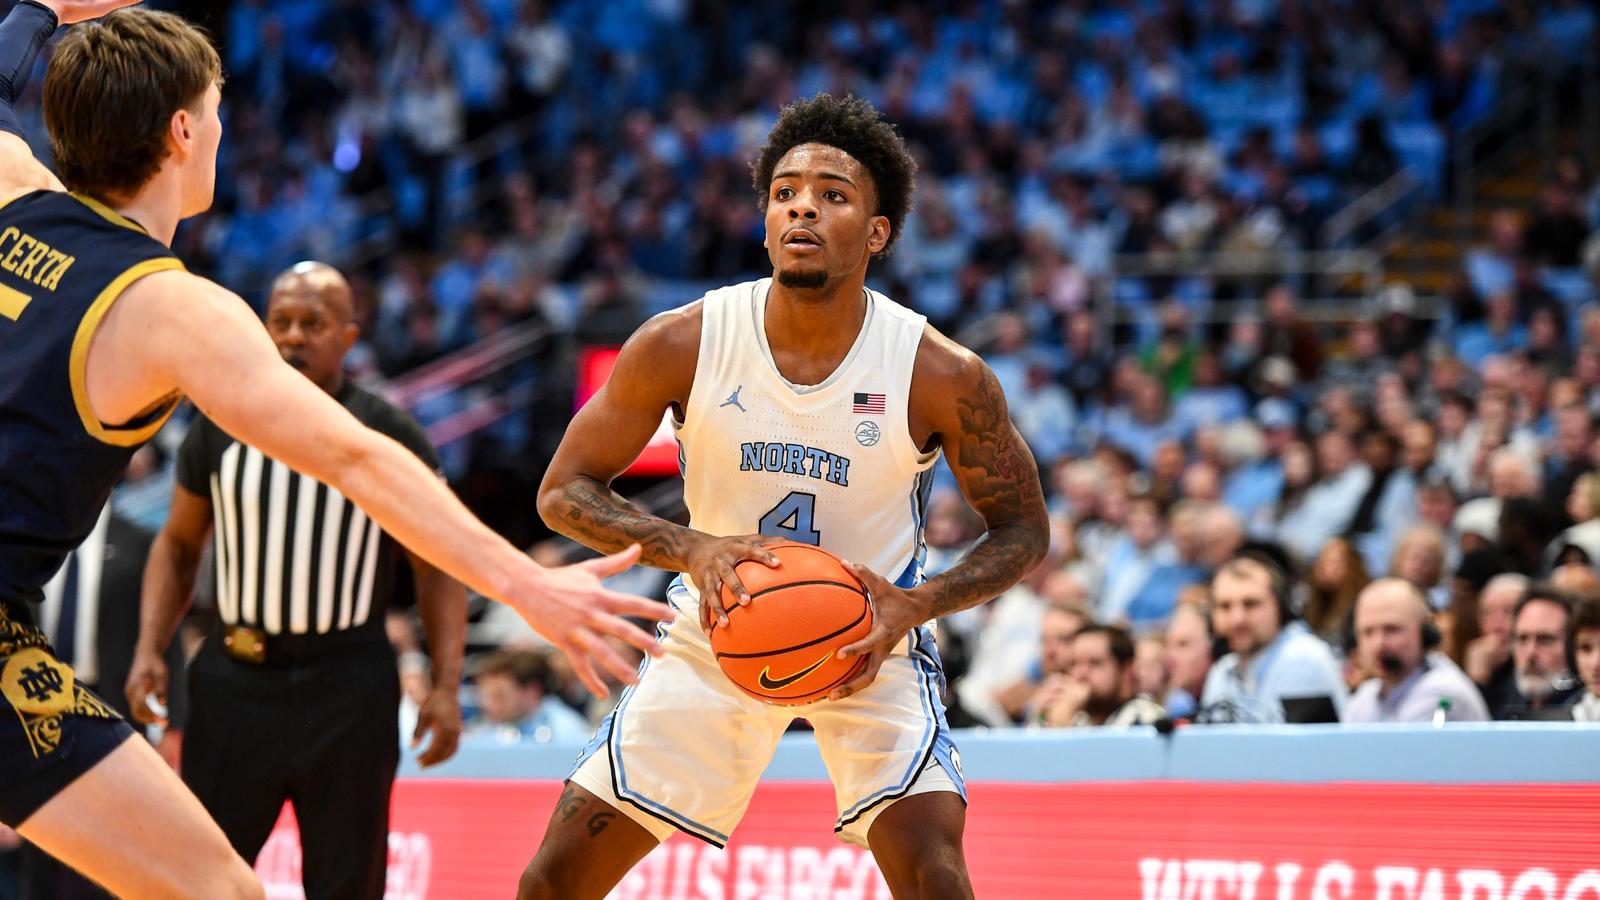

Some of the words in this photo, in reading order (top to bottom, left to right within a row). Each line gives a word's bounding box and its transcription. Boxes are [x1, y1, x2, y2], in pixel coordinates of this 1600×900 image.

[0, 226, 76, 292] CERTA
[740, 441, 850, 487] NORTH
[759, 491, 820, 547] 4
